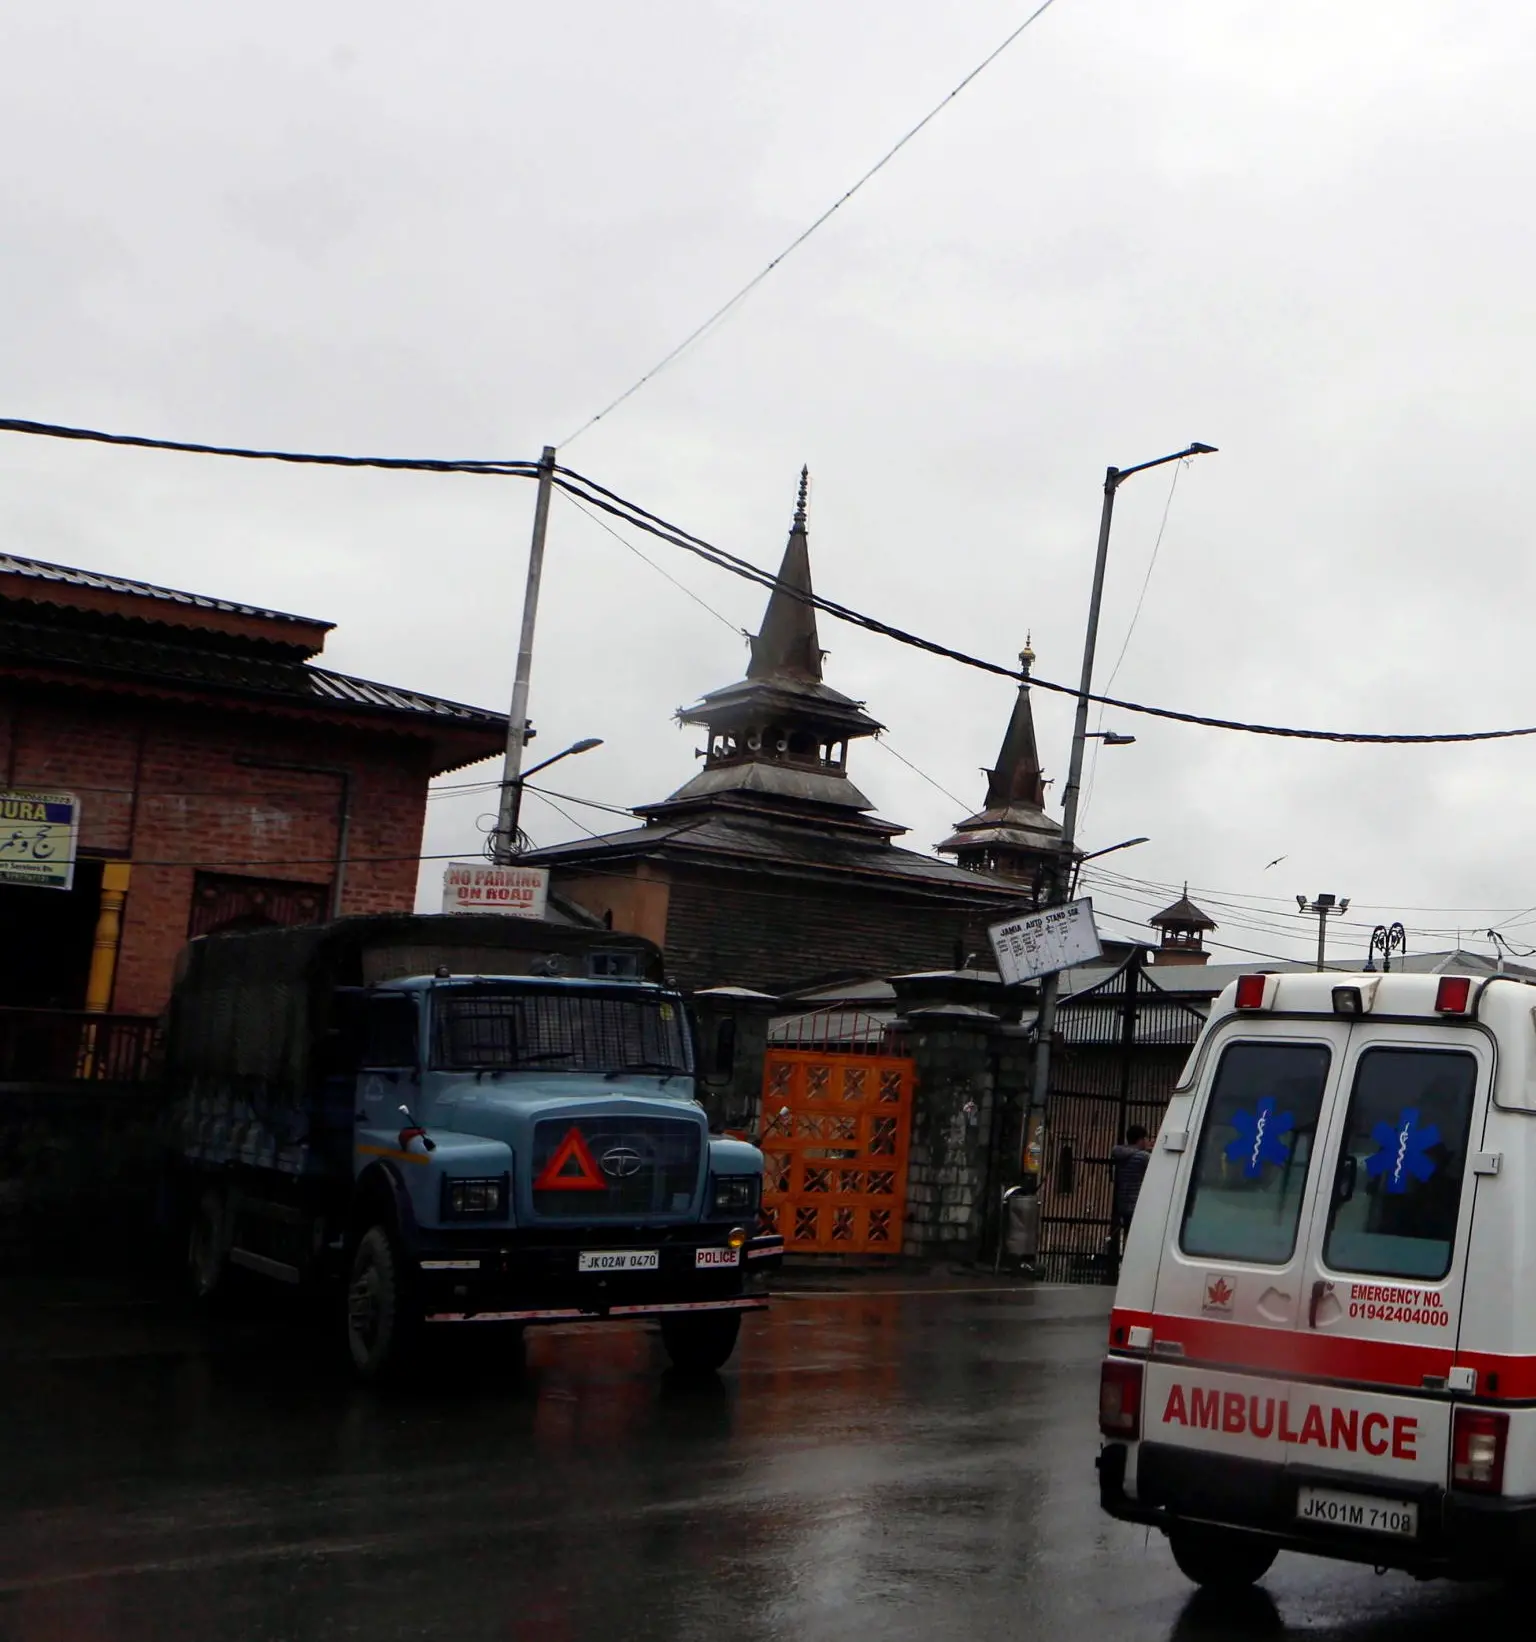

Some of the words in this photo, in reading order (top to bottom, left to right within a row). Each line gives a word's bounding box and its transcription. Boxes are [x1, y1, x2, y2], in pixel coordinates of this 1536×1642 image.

[448, 869, 471, 885] NO
[476, 871, 541, 887] PARKING
[458, 887, 481, 899] ON
[486, 888, 534, 900] ROAD
[1000, 924, 1021, 936] JAMIA
[1026, 918, 1042, 930] AUTO
[1046, 911, 1065, 923] STAND
[588, 1254, 626, 1269] JK02AV
[630, 1254, 656, 1266] 0470
[697, 1250, 737, 1264] POLICE
[1351, 1284, 1421, 1306] EMERGENCY
[1423, 1291, 1443, 1308] NO.
[1349, 1302, 1449, 1327] 01942404000
[1162, 1383, 1418, 1461] AMBULANCE
[1304, 1499, 1363, 1526] JK01M
[1370, 1509, 1411, 1533] 7108
